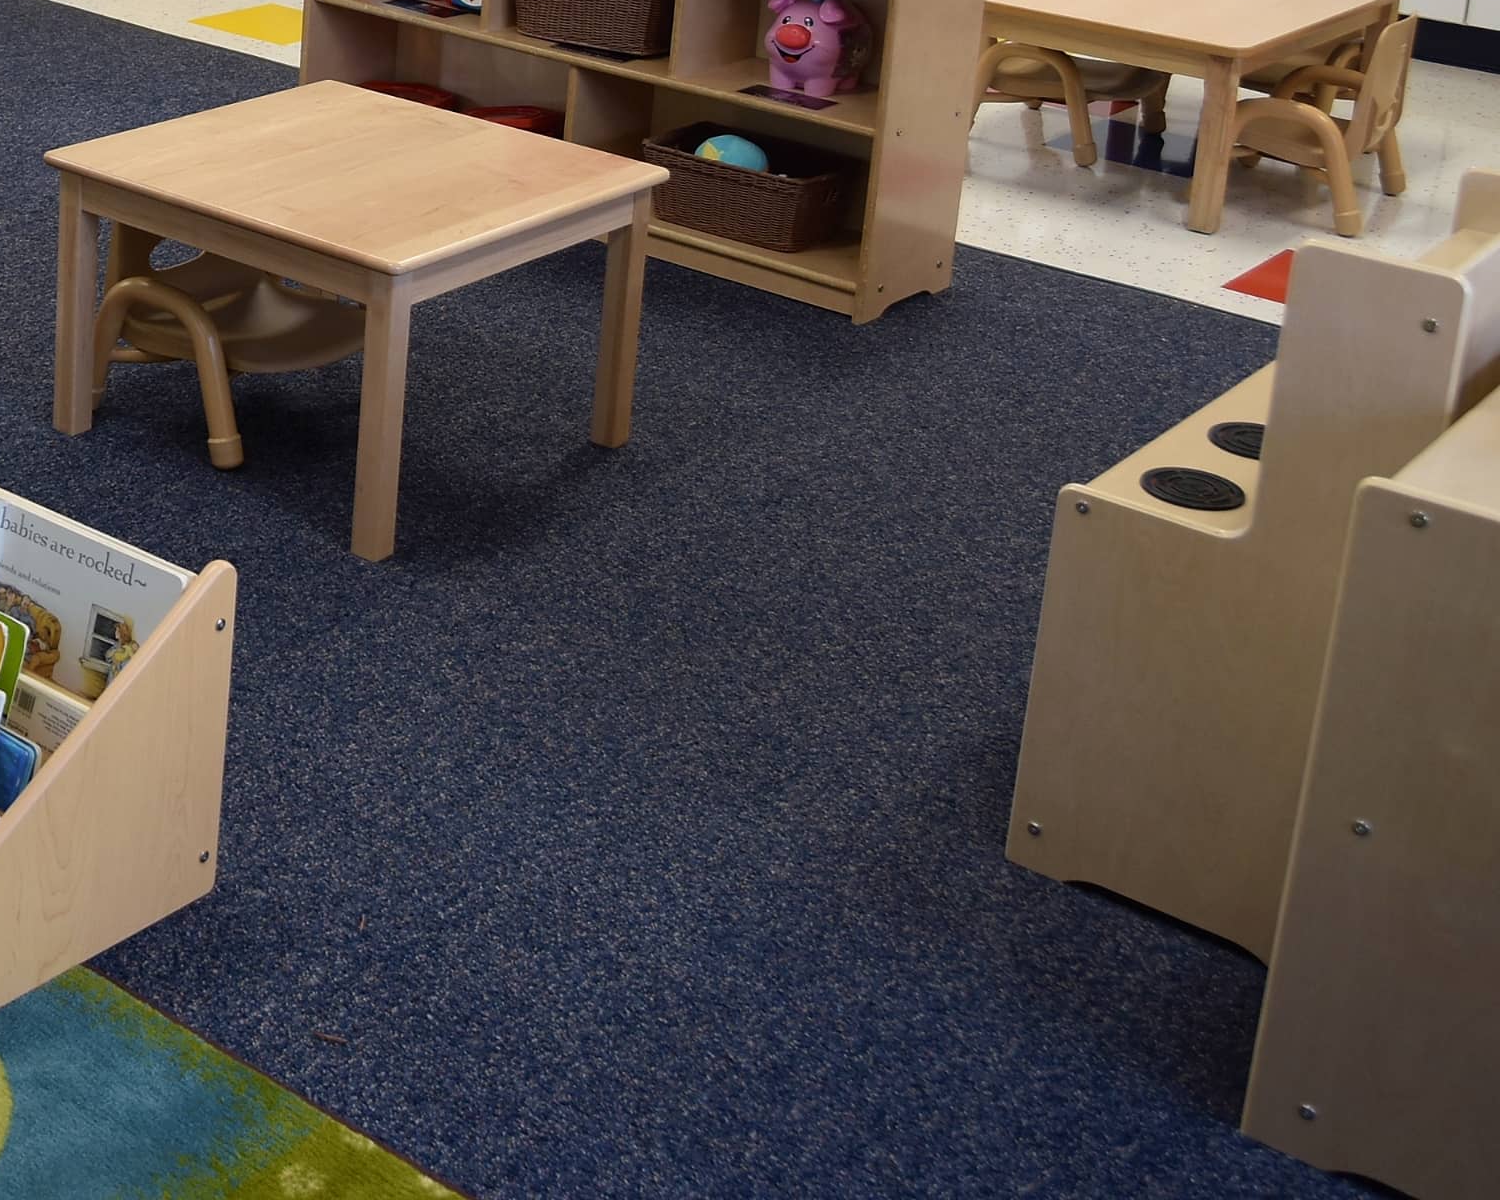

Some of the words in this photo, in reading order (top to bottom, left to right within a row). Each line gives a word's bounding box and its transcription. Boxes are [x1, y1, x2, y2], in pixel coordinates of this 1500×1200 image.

[0, 506, 49, 548] babies
[50, 538, 76, 560] are
[17, 567, 32, 582] and
